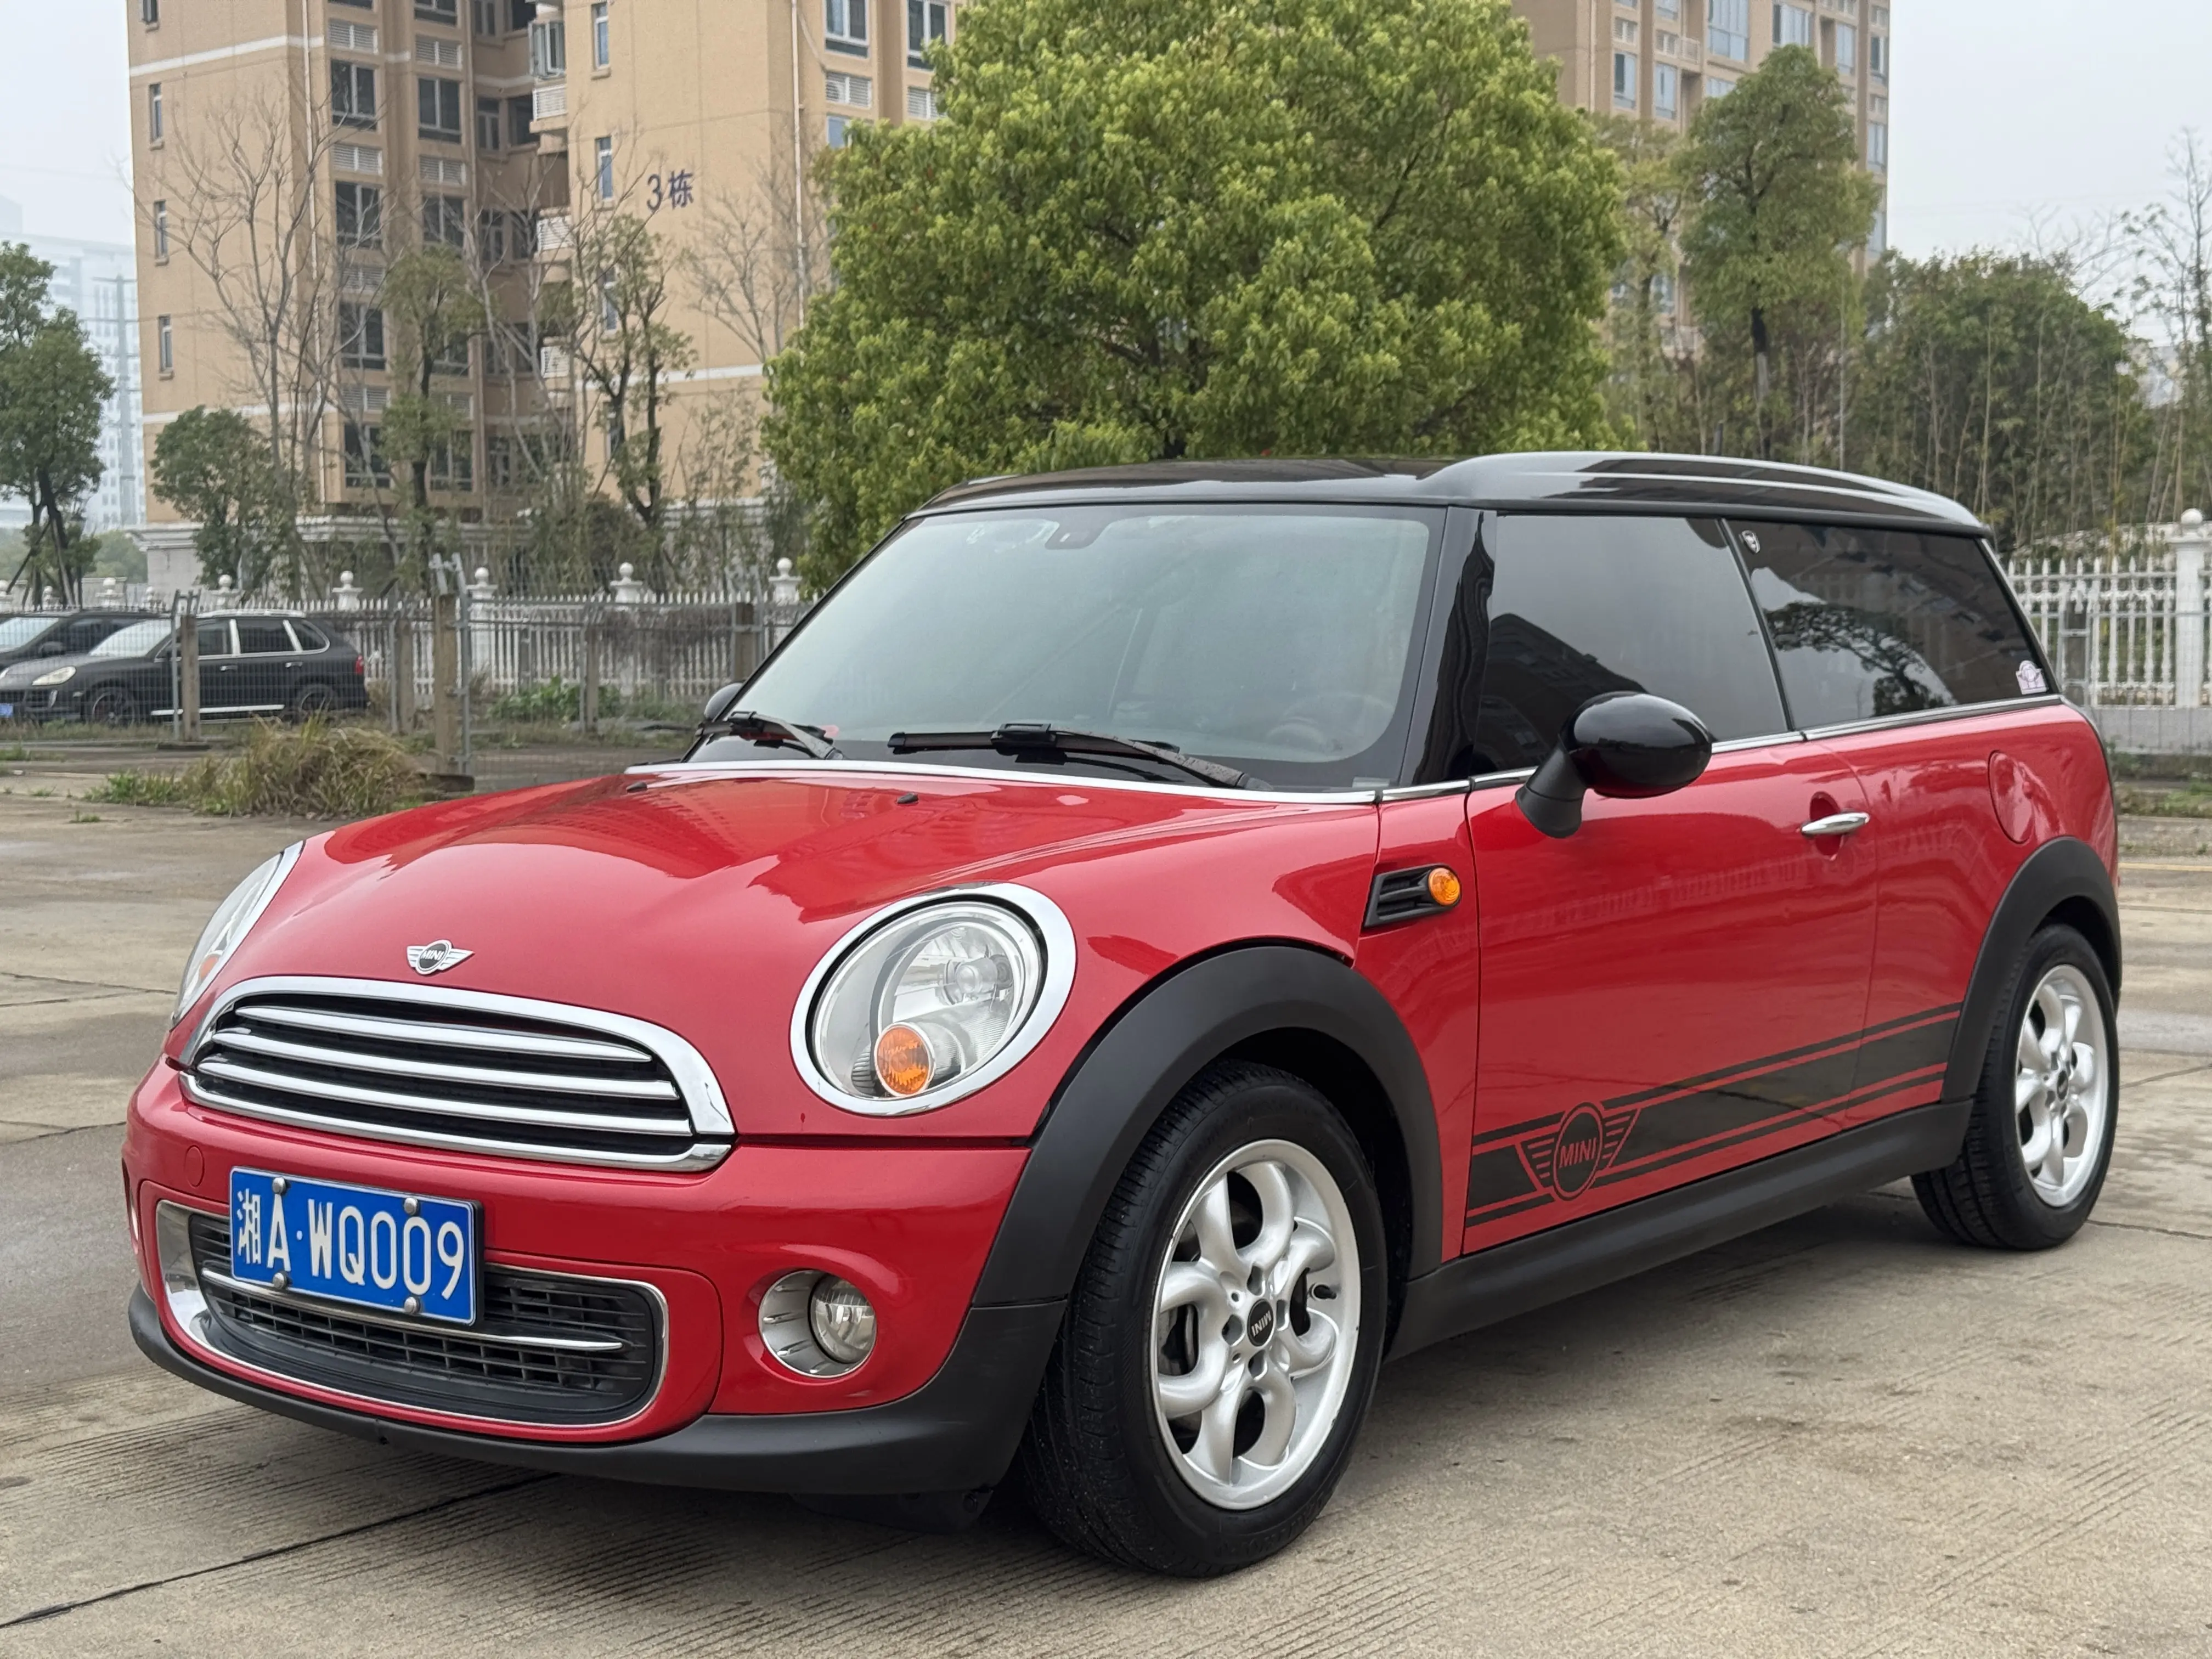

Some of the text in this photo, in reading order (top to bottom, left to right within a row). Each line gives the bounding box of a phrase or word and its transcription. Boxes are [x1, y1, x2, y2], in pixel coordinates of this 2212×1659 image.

[646, 169, 695, 212] 3栋
[420, 950, 445, 961] MINI
[1559, 1137, 1597, 1169] MINI
[1251, 1310, 1272, 1338] MINI
